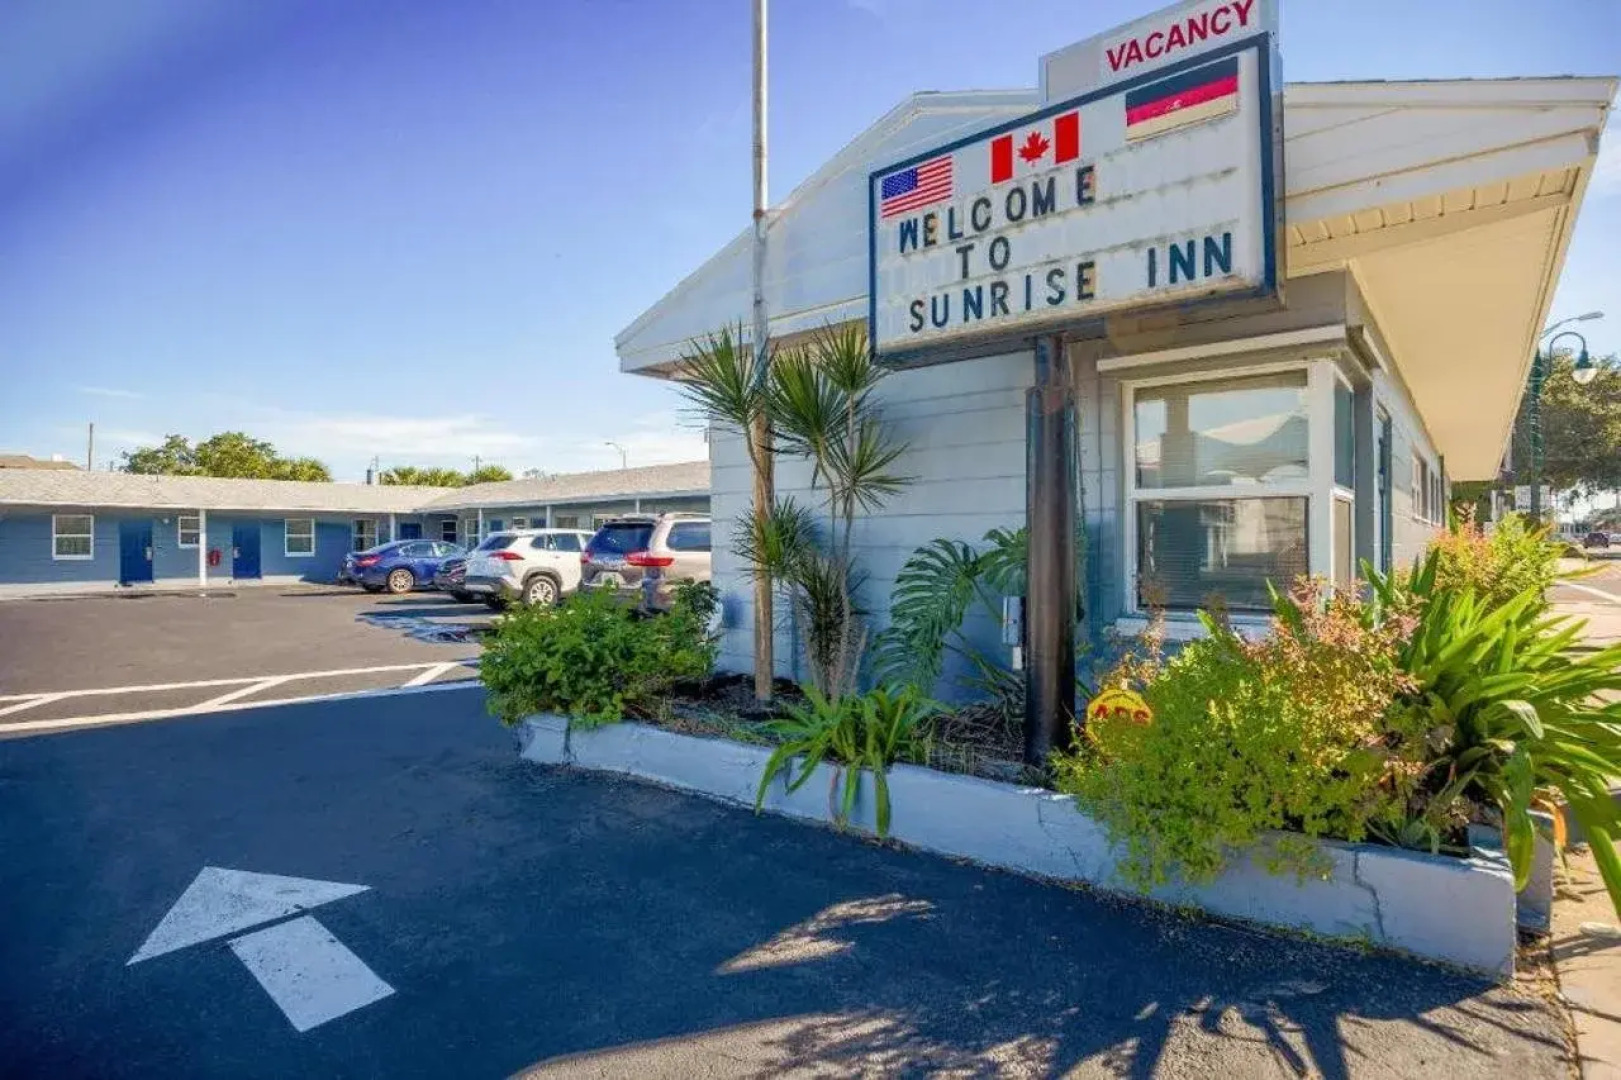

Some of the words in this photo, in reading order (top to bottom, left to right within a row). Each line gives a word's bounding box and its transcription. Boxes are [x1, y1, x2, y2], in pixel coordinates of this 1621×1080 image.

[1106, 0, 1254, 71] VACANCY
[899, 165, 1096, 253] WELCOME
[909, 261, 1095, 333] SUNRISE
[1147, 231, 1232, 288] INN
[956, 236, 1011, 279] TO
